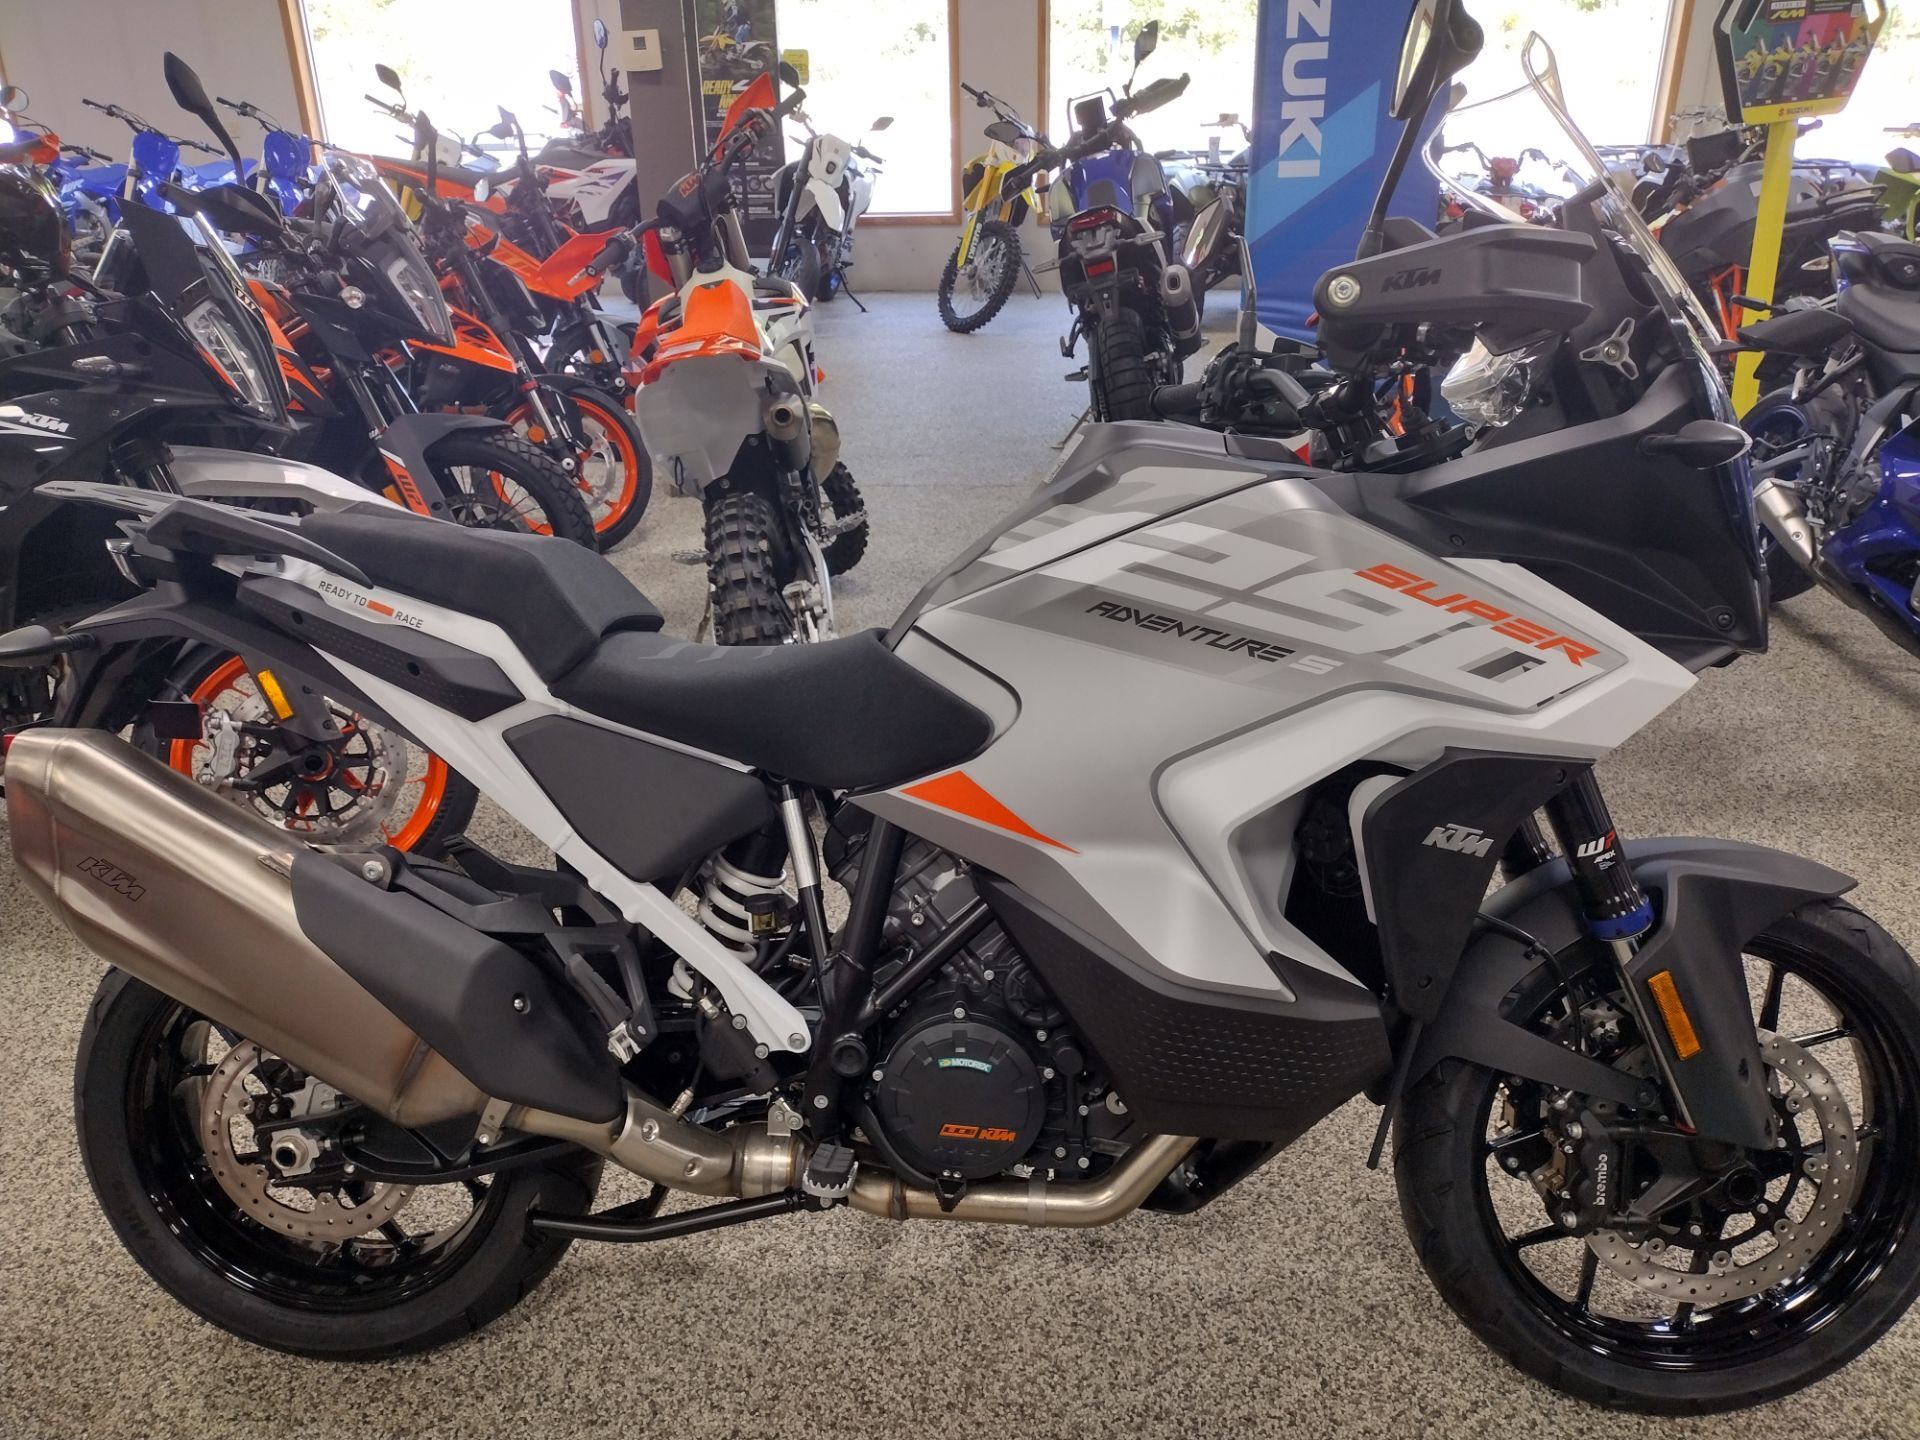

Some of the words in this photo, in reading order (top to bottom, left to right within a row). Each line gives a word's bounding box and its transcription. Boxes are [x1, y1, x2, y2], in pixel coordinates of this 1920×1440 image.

[967, 222, 983, 259] SUZUKI
[1381, 267, 1442, 293] KTM
[19, 412, 70, 433] KTM
[318, 580, 353, 600] READY
[354, 594, 368, 607] TO
[394, 611, 424, 629] RACE
[1353, 563, 1601, 667] SUPER
[1085, 601, 1297, 662] ADVENTURE
[1288, 655, 1345, 675] S
[1421, 823, 1495, 858] KTM
[76, 856, 146, 902] KTM
[951, 1058, 992, 1073] MOTOREX
[979, 1127, 1016, 1142] KTM
[1592, 1153, 1608, 1206] brembo
